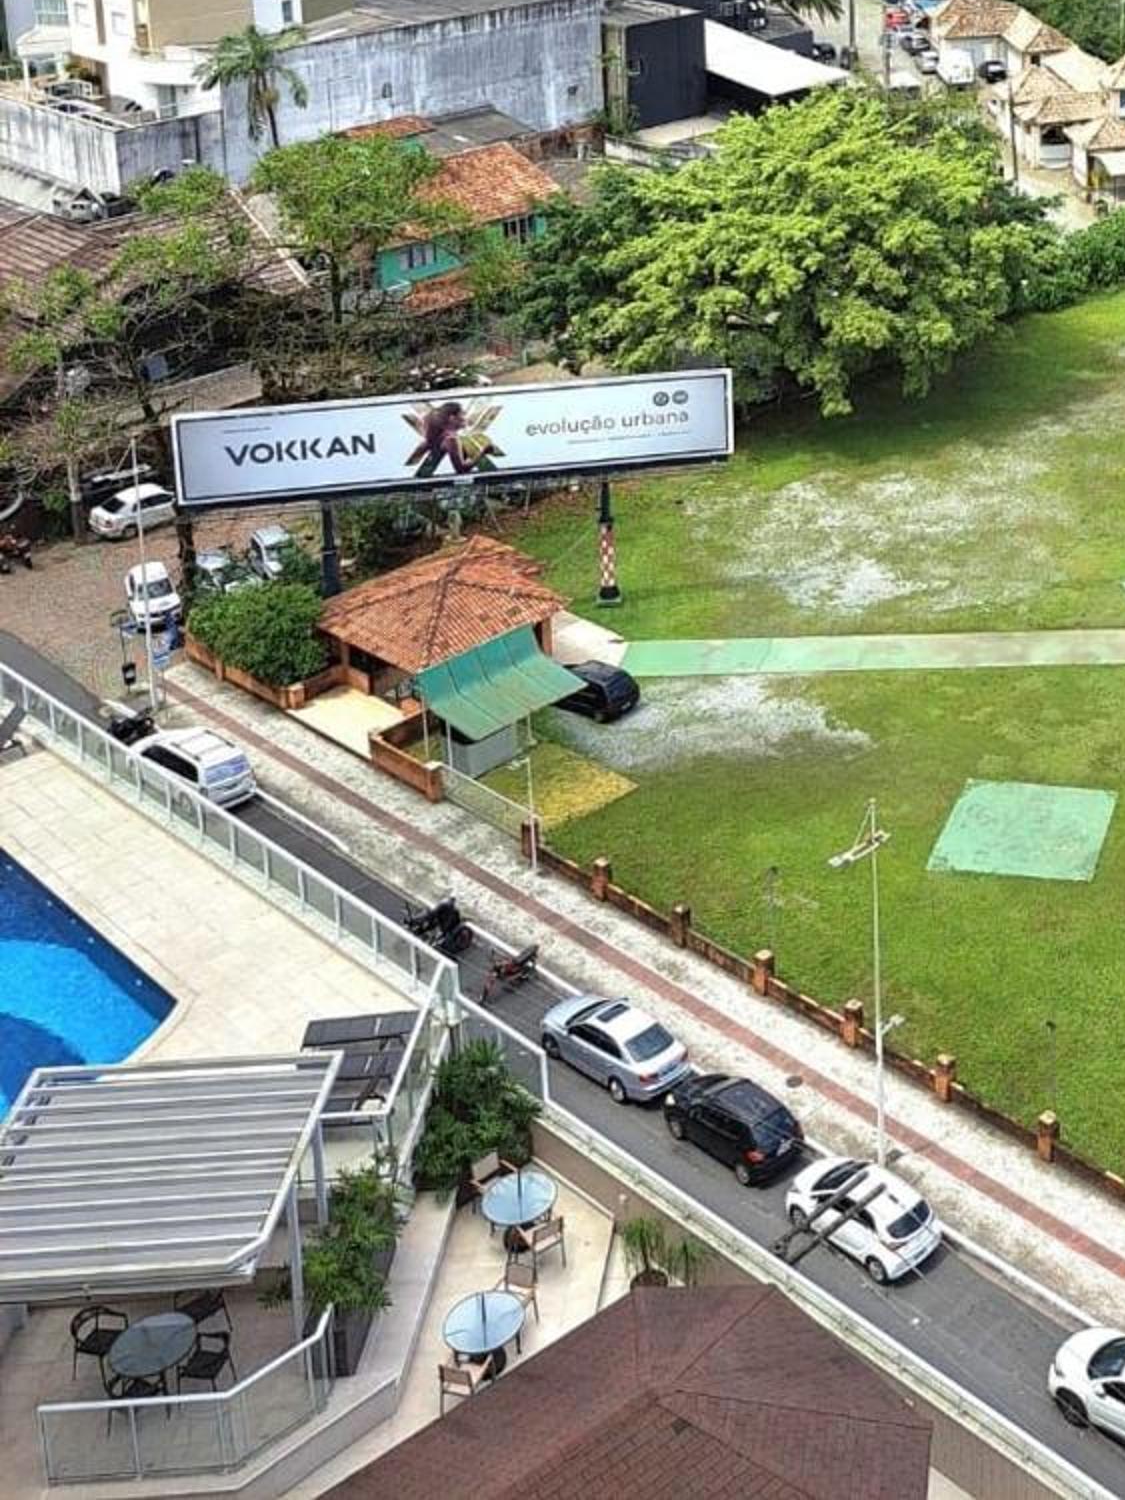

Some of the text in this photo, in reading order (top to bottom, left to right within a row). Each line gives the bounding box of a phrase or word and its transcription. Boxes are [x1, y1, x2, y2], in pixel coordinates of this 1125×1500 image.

[525, 415, 616, 437] evolução
[620, 410, 690, 429] urbana
[224, 433, 376, 467] VOKKAN
